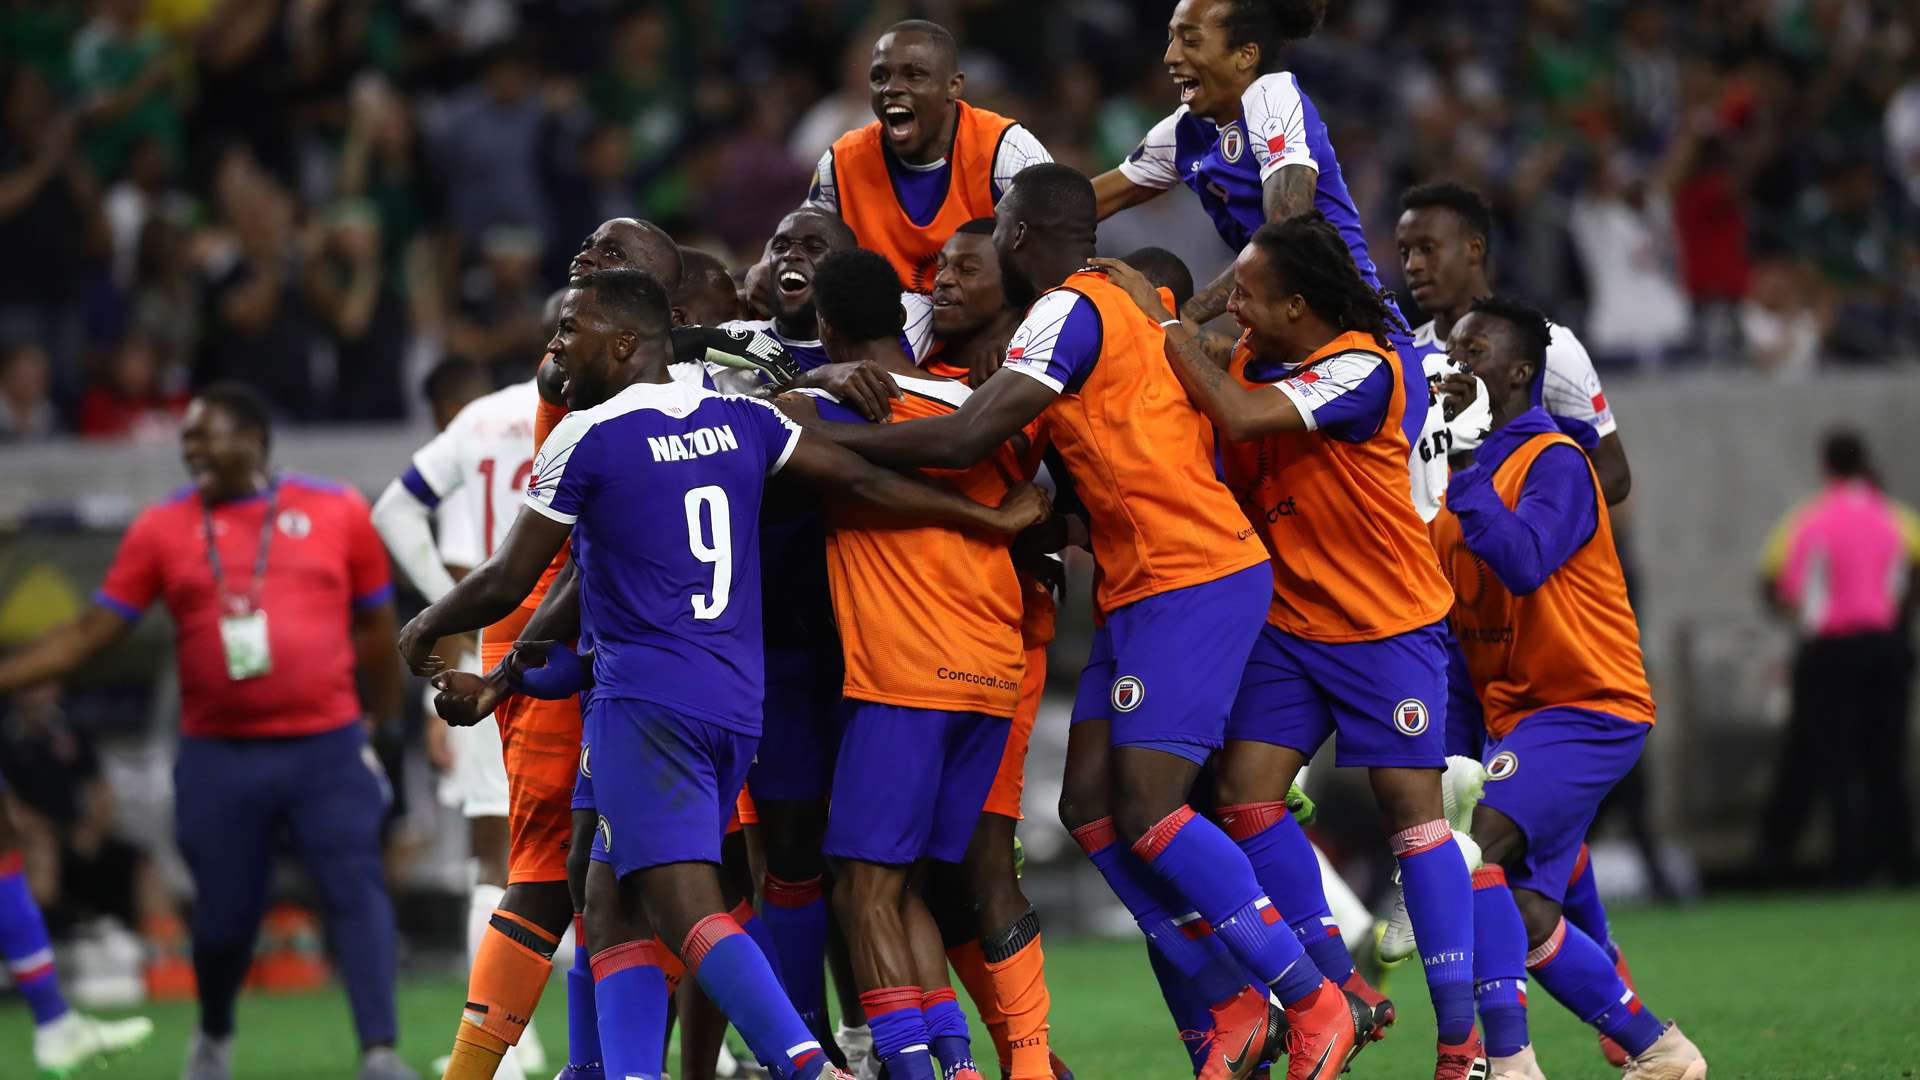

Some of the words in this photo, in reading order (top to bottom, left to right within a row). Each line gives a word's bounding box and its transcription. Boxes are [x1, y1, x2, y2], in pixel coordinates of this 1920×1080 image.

[647, 424, 739, 462] NAZON
[684, 485, 732, 619] 9
[937, 667, 1018, 691] Concacaf.com
